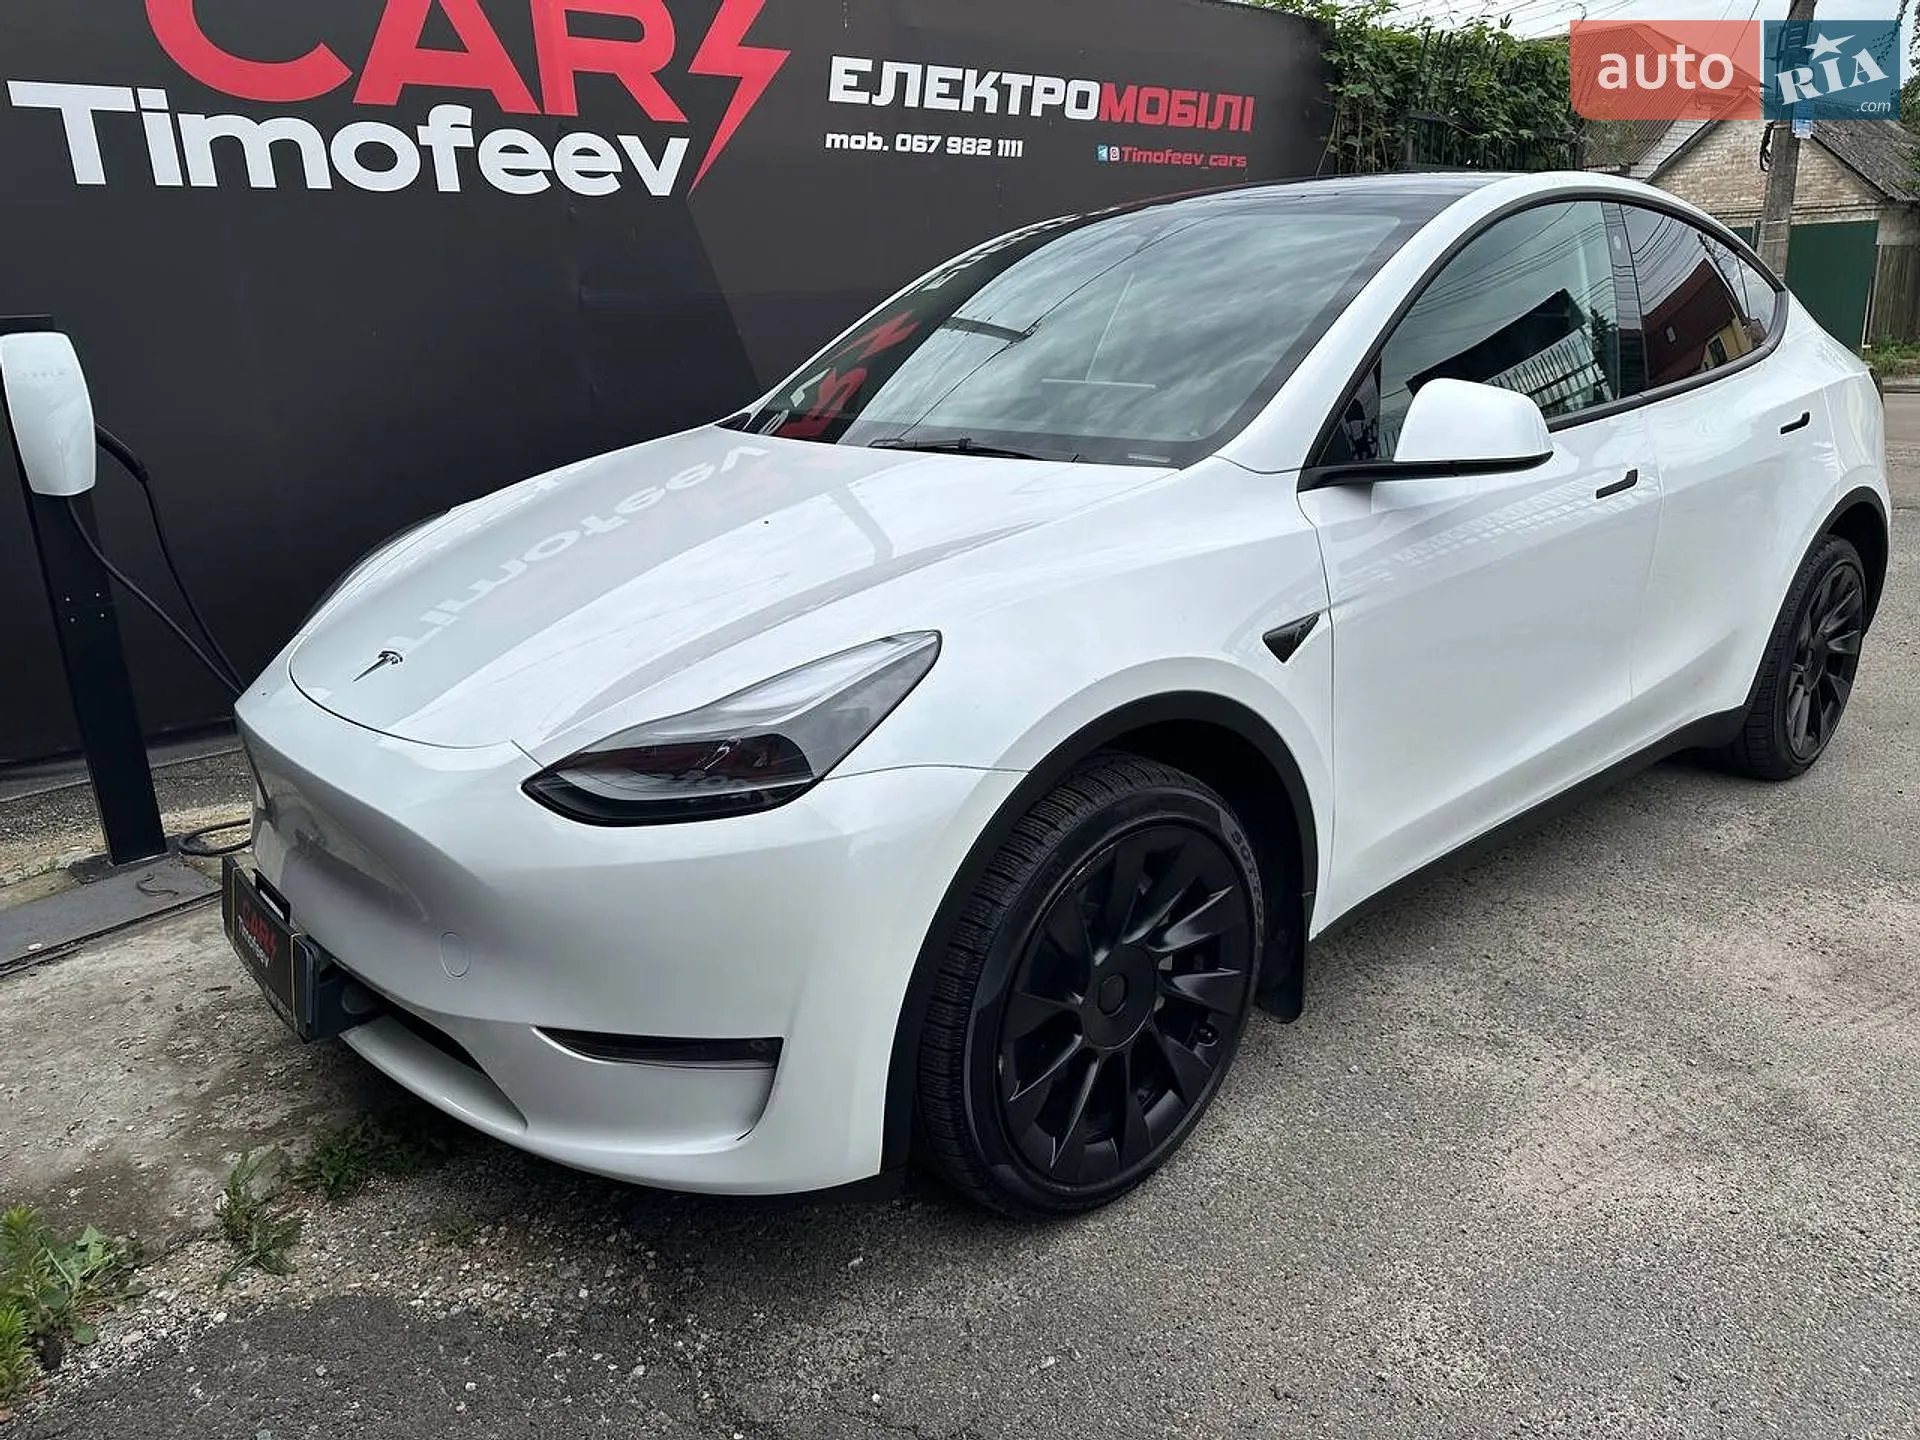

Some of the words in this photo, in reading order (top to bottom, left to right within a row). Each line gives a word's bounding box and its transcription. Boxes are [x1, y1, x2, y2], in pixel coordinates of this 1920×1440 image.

[828, 55, 1255, 132] ЕЛЕКТРОМОБІЛІ
[7, 80, 690, 197] Timofeev
[825, 132, 889, 151] mob.
[895, 133, 942, 153] 067
[946, 136, 992, 156] 982
[997, 139, 1023, 157] 1111
